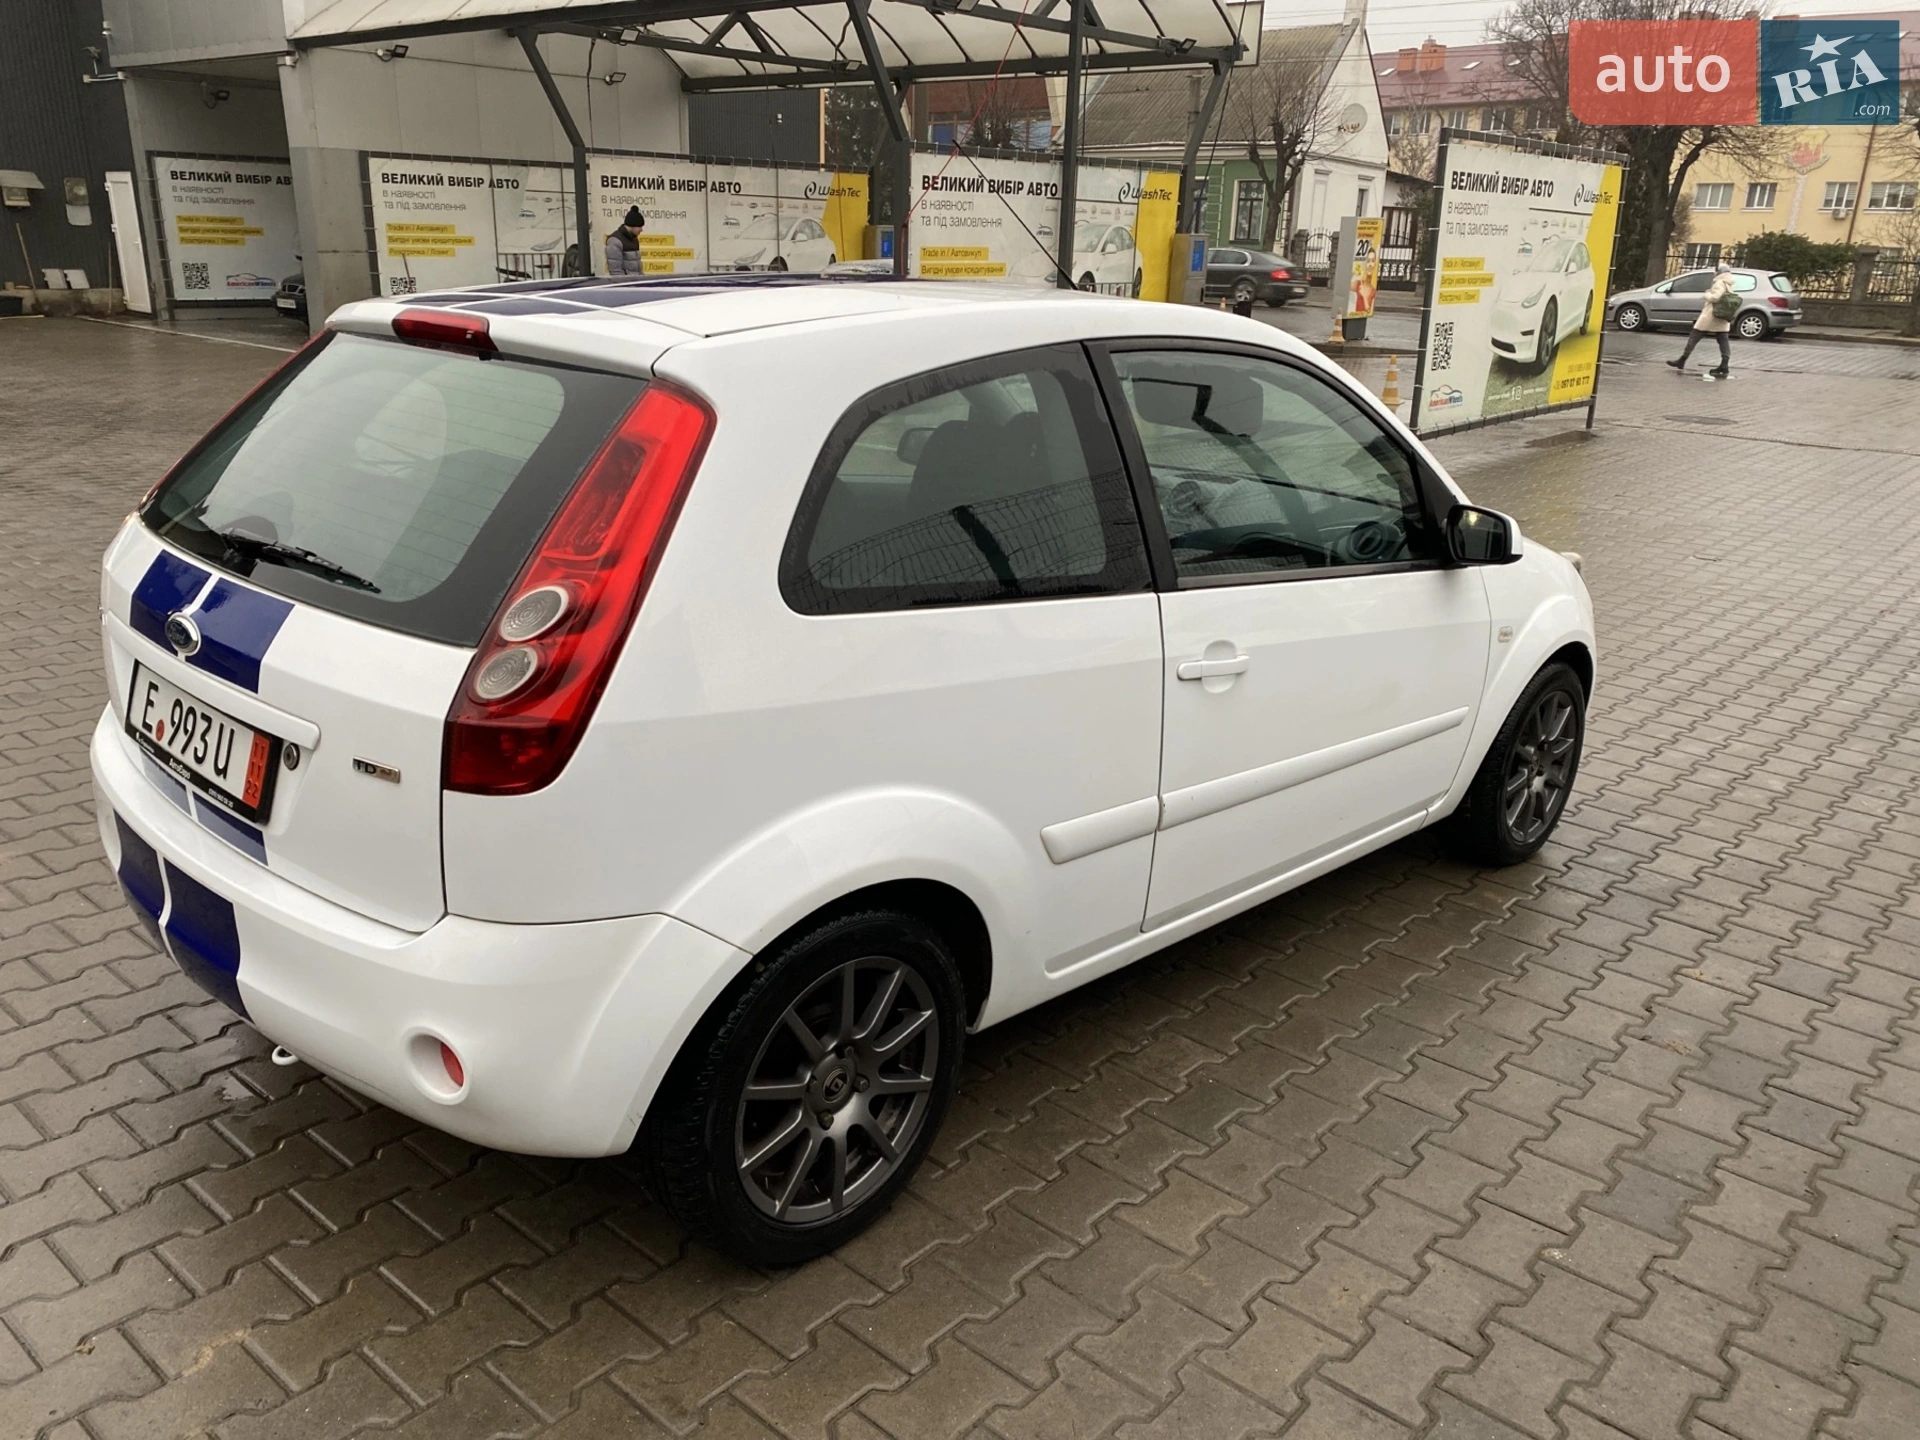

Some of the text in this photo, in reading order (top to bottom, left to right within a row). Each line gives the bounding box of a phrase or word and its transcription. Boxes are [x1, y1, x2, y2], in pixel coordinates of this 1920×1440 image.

[170, 170, 231, 183] ВЕЛИКИЙ
[236, 173, 272, 185] ВИБІР
[381, 172, 520, 190] ВЕЛИКИЙ ВИБІР АВТО
[601, 175, 742, 194] ВЕЛИКИЙ ВИБІР АВТО
[1451, 171, 1554, 198] ВЕЛИКИЙ ВИБІР АВТО
[180, 185, 224, 194] наявності
[817, 187, 861, 198] WashTec
[922, 175, 1058, 197] ВЕЛИКИЙ ВИБІР АВТО
[173, 195, 183, 203] та
[391, 189, 436, 199] наявності
[610, 194, 656, 205] наявності
[1131, 188, 1172, 200] WashTec
[1583, 190, 1613, 205] WashTec
[384, 201, 467, 212] та під замовлення
[929, 198, 974, 211] наявності
[1454, 200, 1489, 216] наявності
[602, 208, 612, 217] та
[642, 209, 687, 219] мовлення
[921, 213, 1002, 229] та під замовлення
[1446, 218, 1509, 238] та під замовлення
[922, 248, 939, 257] Trade
[950, 248, 982, 259] Автовикуп
[1355, 239, 1369, 257] 20
[142, 680, 159, 733] E
